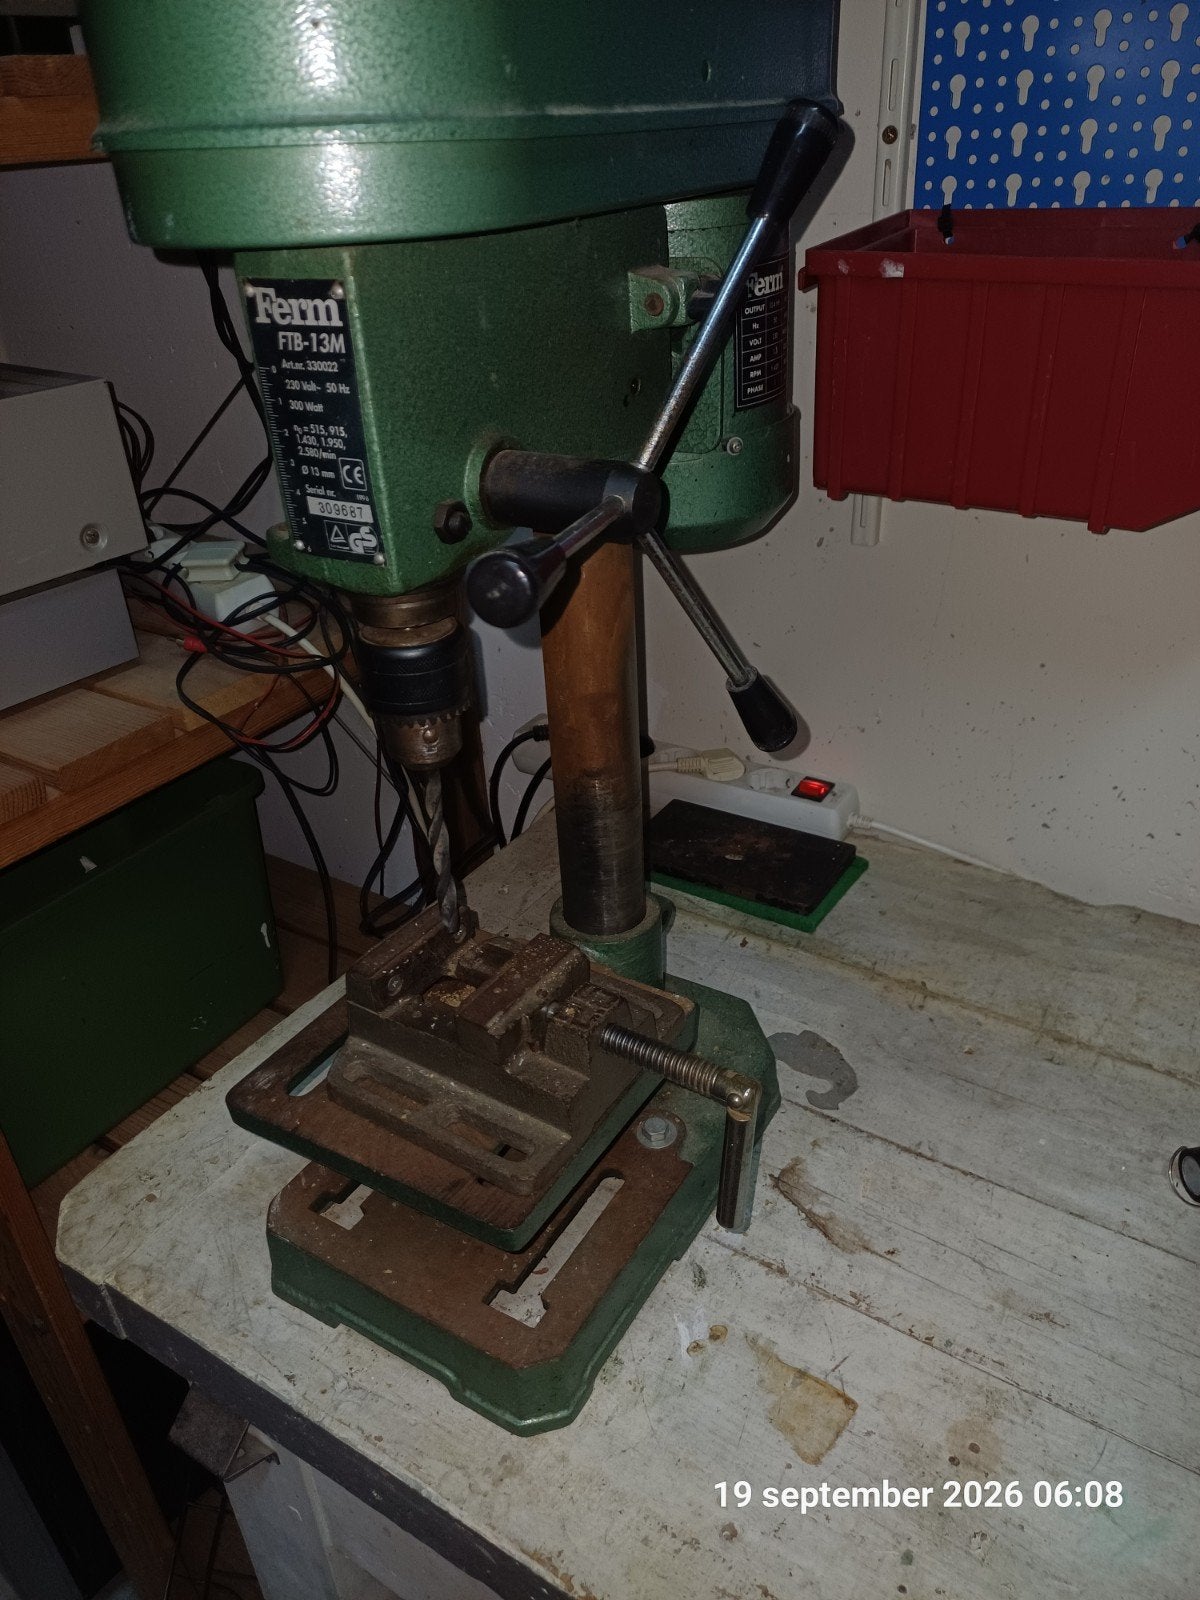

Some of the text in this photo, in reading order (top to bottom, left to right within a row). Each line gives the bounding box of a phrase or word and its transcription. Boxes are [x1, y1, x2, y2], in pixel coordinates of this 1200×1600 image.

[253, 286, 344, 327] Ferm
[744, 303, 765, 315] OUTPUT
[278, 331, 346, 354] FTB-13M
[749, 338, 762, 346] VOLT
[750, 354, 762, 363] AMP
[306, 360, 339, 373] 330022
[749, 370, 762, 379] RPM
[285, 379, 301, 391] 230
[326, 382, 338, 394] 50
[338, 383, 351, 395] Hz
[747, 384, 764, 395] PHASE
[289, 399, 325, 413] 300 Watt
[310, 423, 329, 437] 515,
[329, 425, 348, 438] 915,
[295, 434, 347, 451] 1.430, 1.950,
[297, 445, 337, 460] 2.580/min
[310, 466, 321, 477] 13
[321, 470, 336, 479] mm
[305, 483, 326, 496] Serial
[318, 501, 364, 519] 309687
